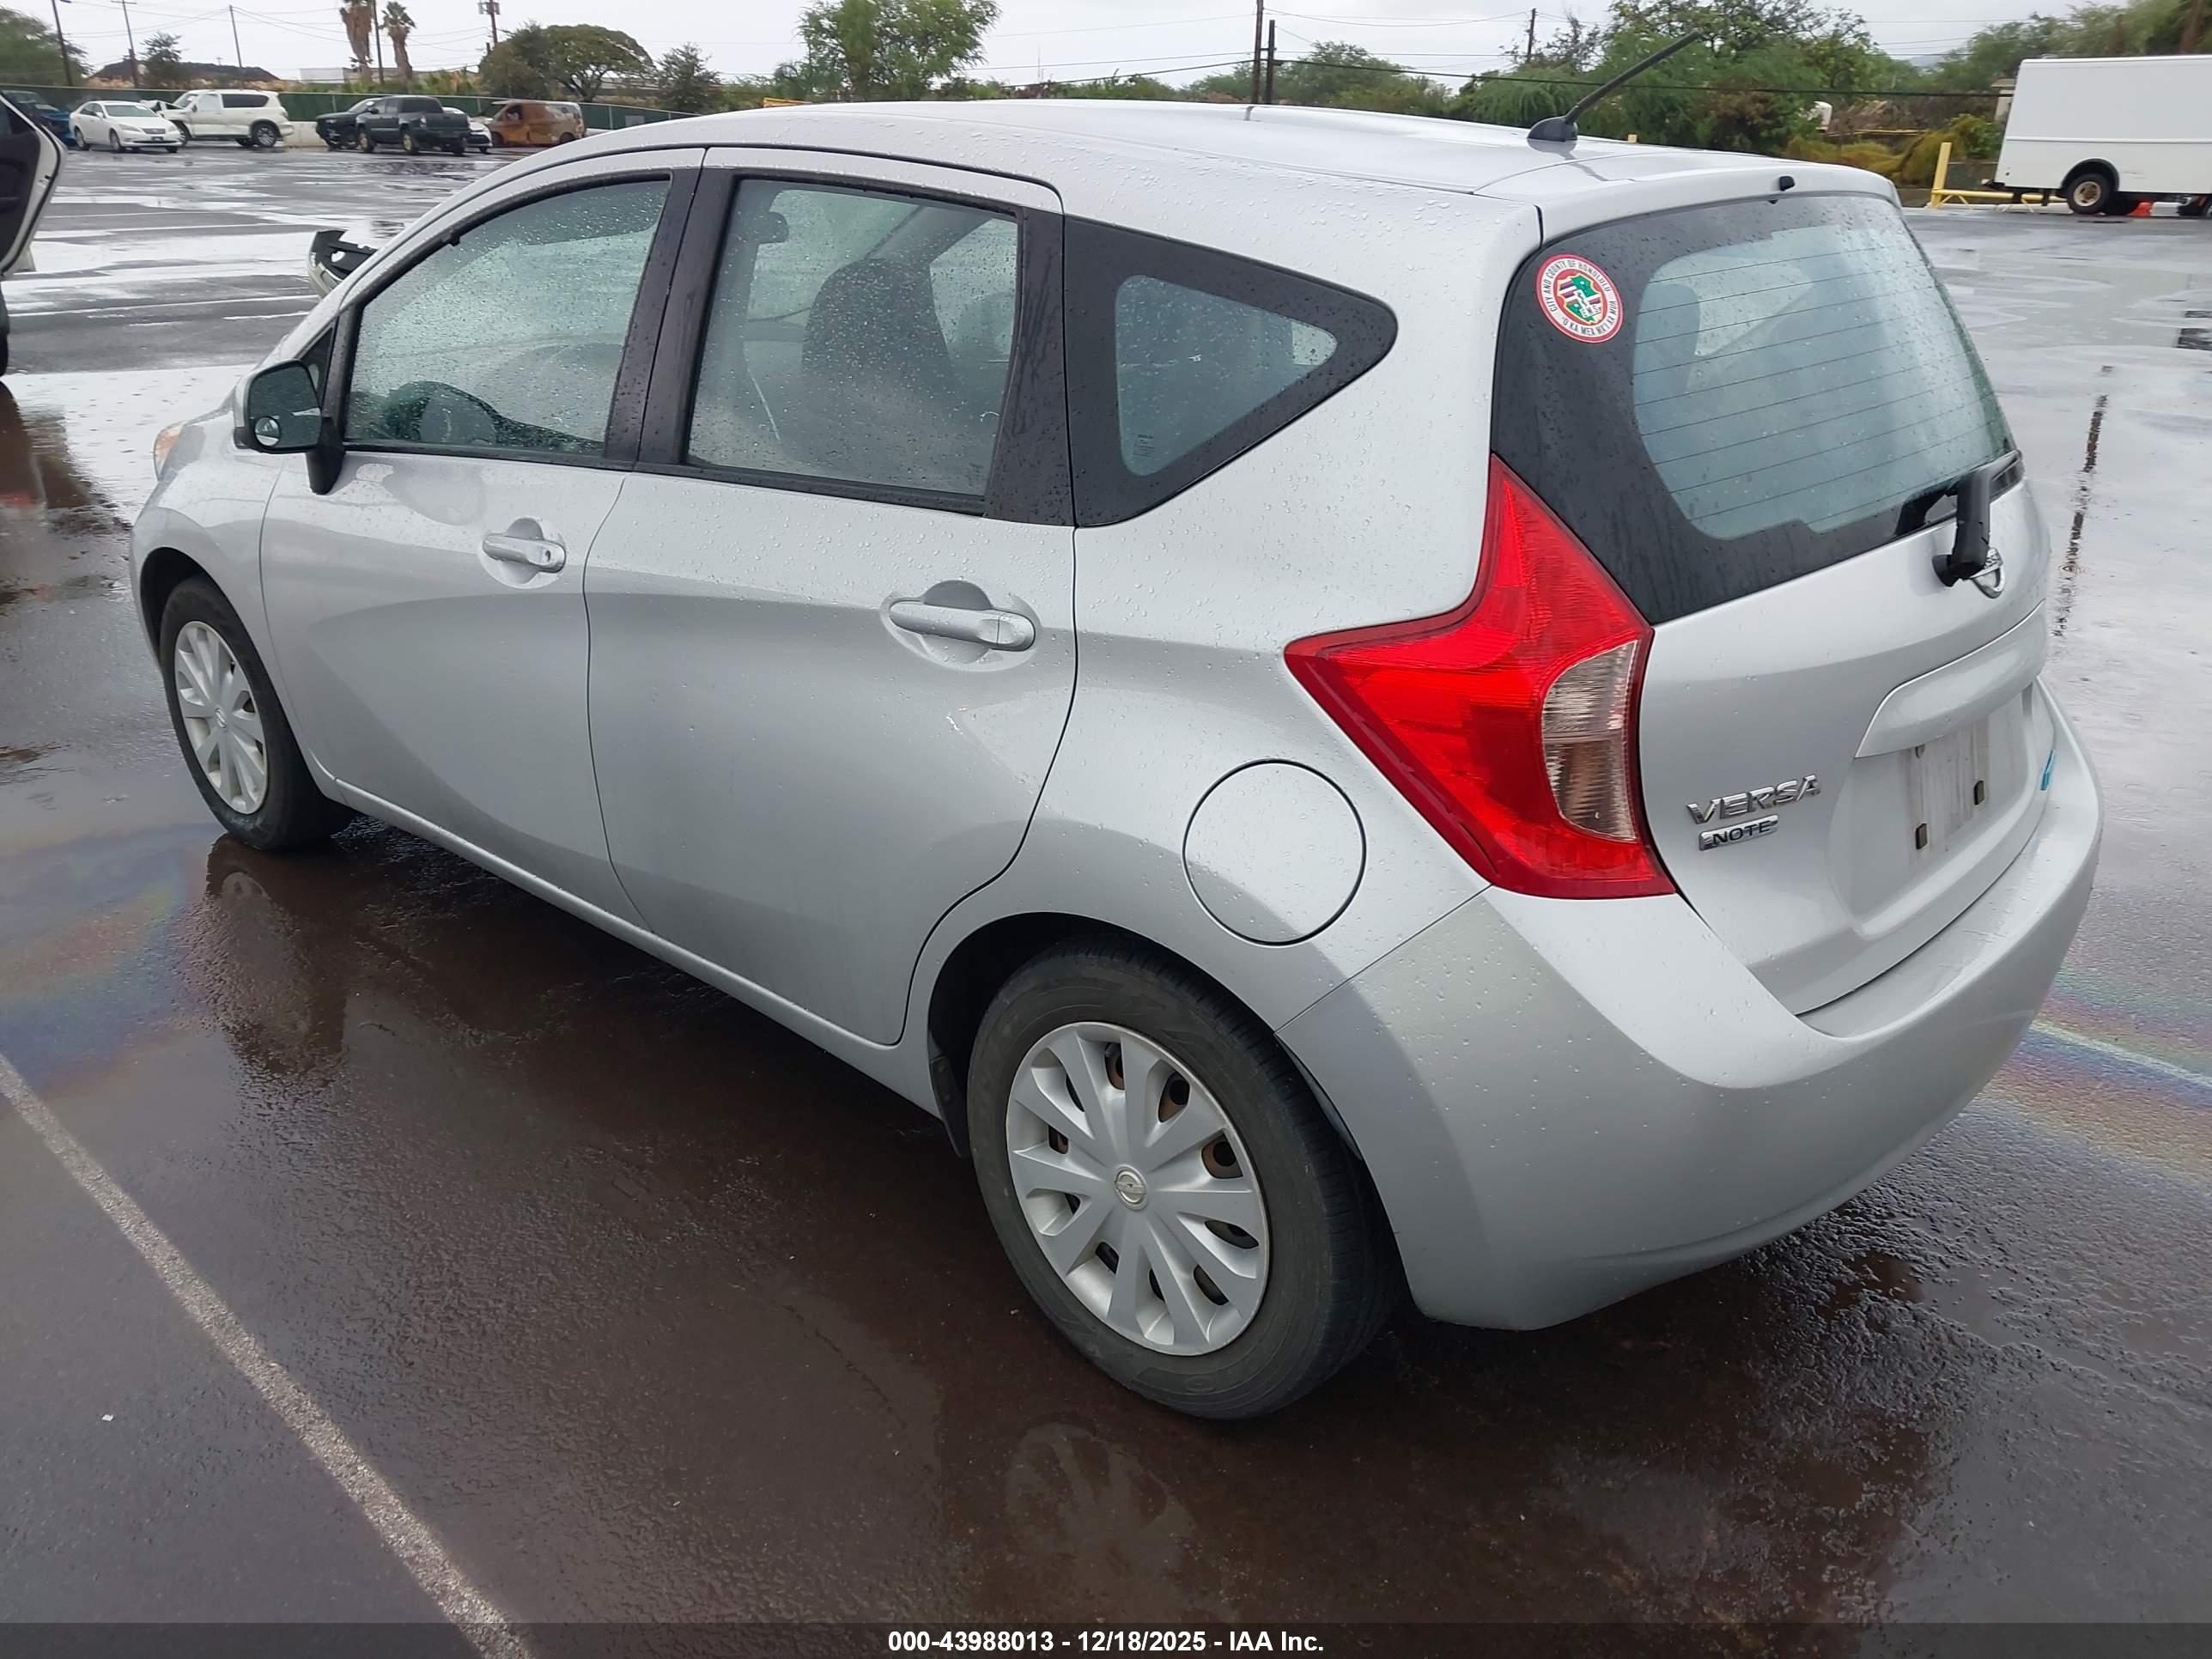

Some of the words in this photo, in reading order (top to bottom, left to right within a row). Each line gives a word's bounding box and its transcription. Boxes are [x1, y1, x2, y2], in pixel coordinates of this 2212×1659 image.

[1547, 260, 1567, 279] COUNTY
[1543, 279, 1553, 294] AND
[1545, 297, 1558, 312] CITY
[1686, 774, 1820, 824] VERSA
[1712, 819, 1772, 845] NOTE
